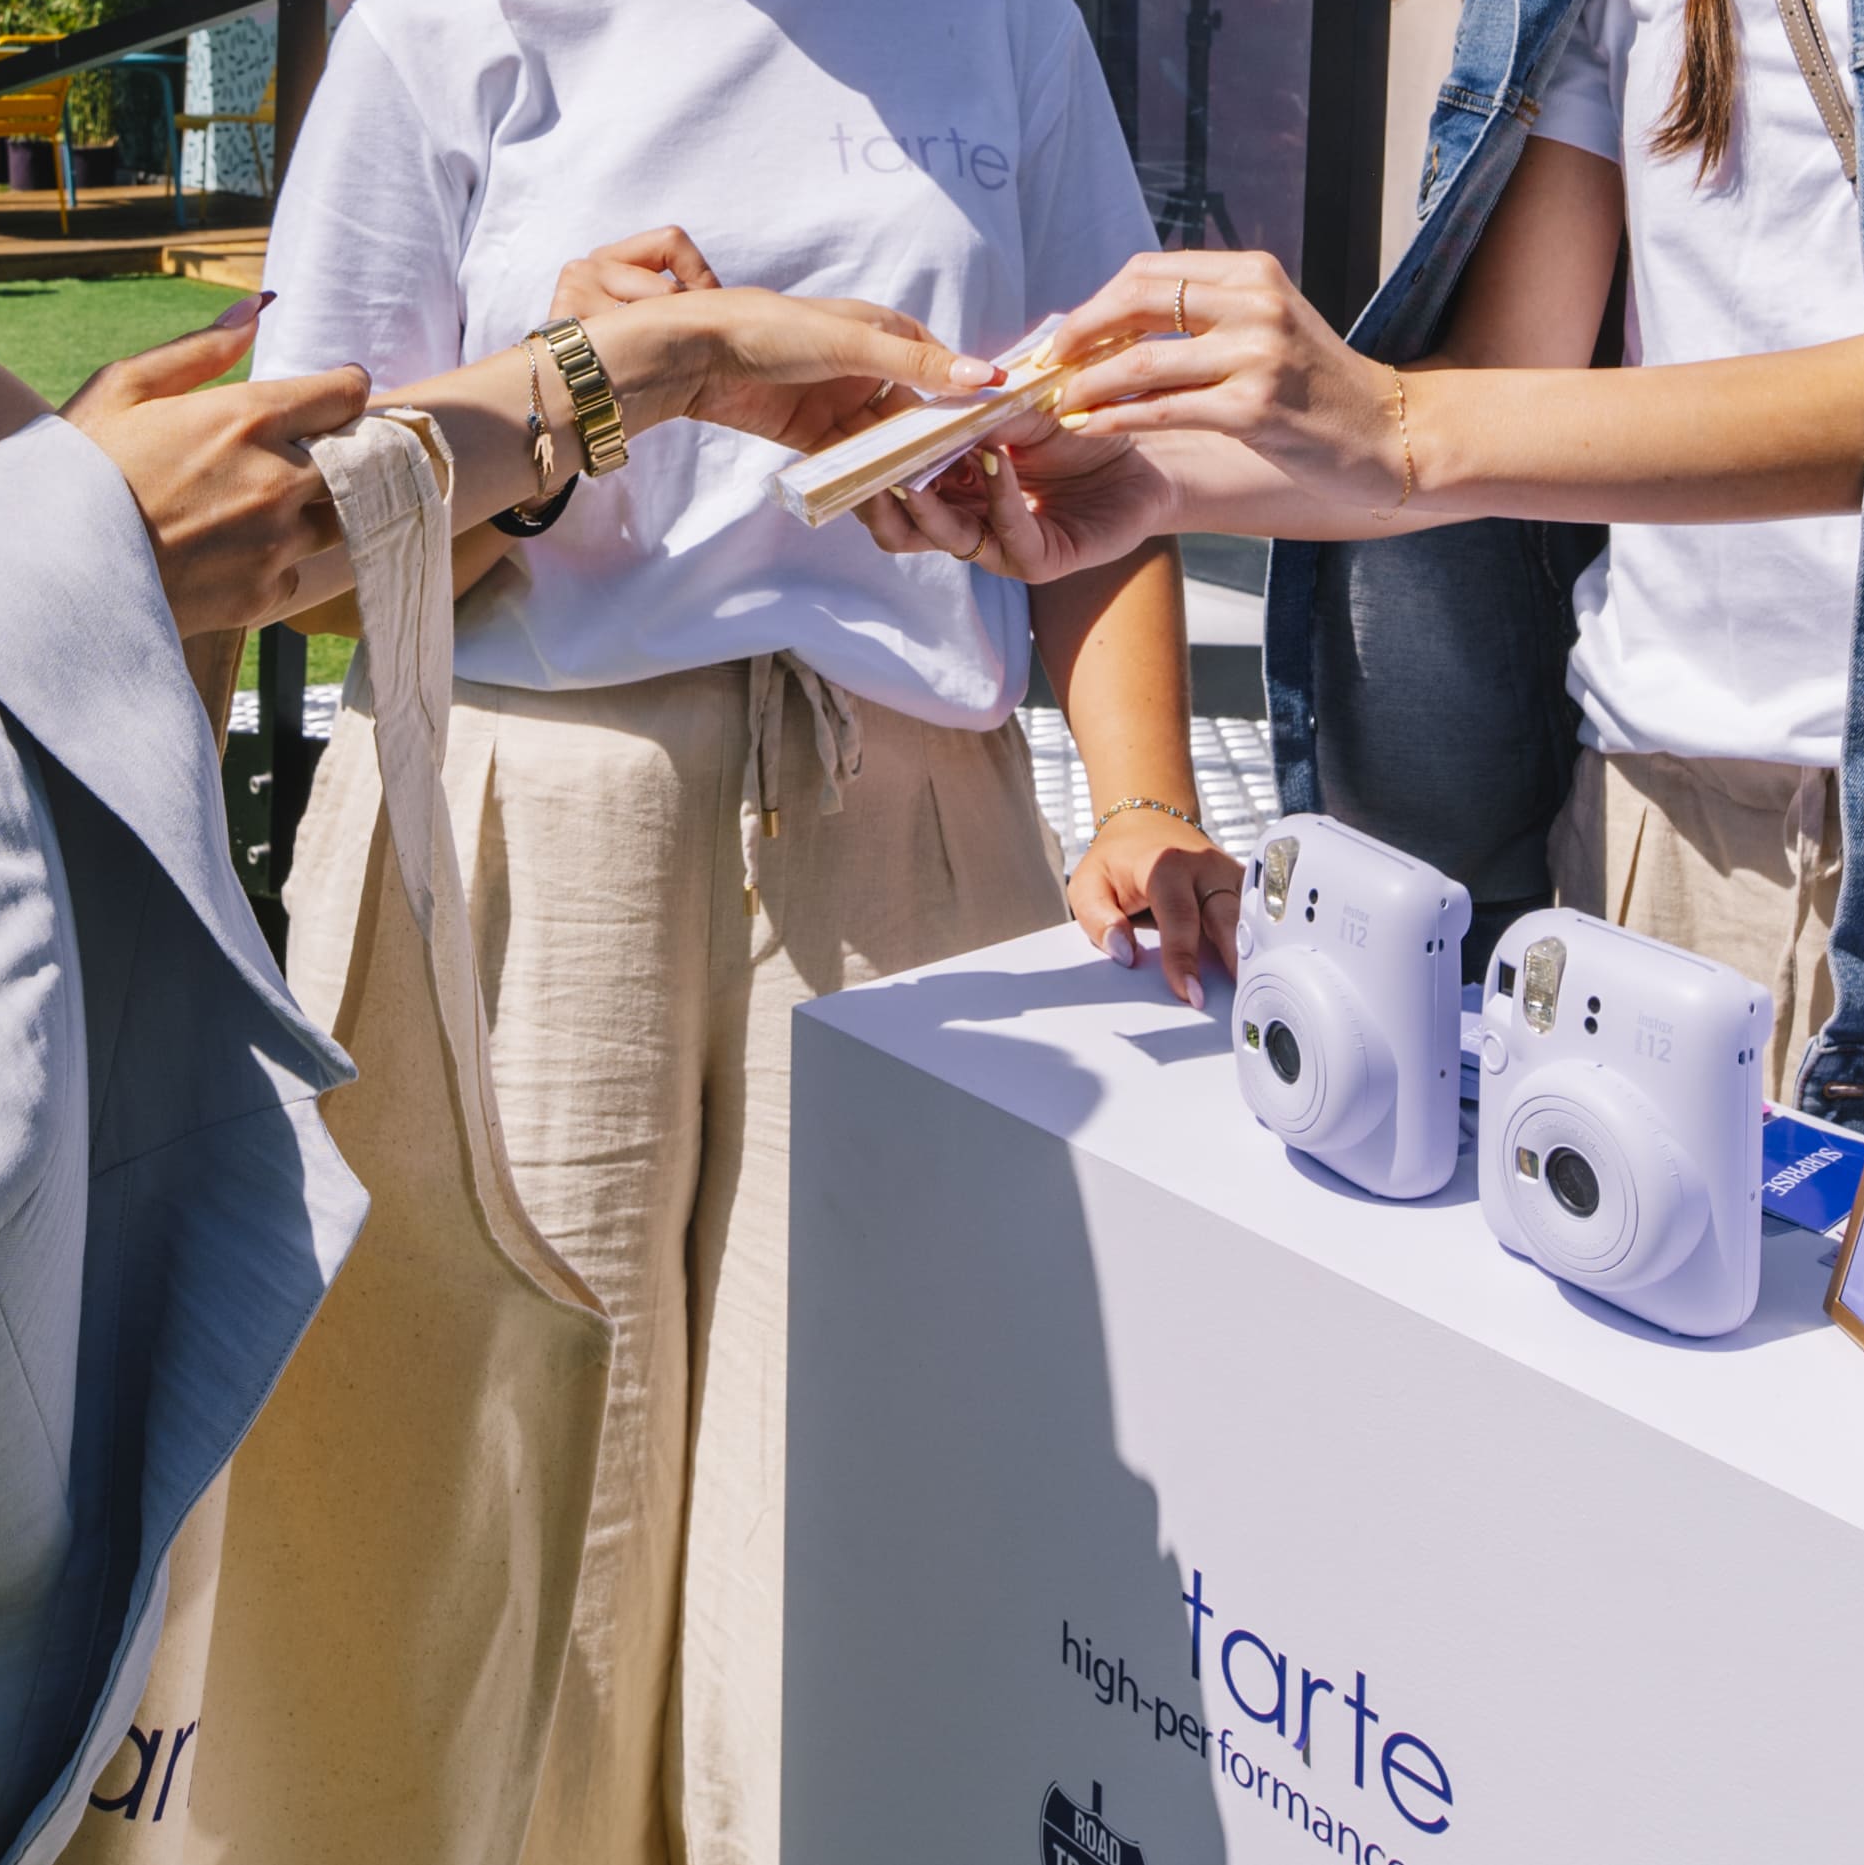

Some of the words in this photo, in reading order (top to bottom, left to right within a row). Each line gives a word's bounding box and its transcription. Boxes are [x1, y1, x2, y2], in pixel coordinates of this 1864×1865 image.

[830, 122, 1011, 191] tarte
[1761, 1147, 1844, 1197] SURPRISE
[1182, 1568, 1453, 1835] tarte
[1062, 1620, 1403, 1865] high-performanc
[1074, 1809, 1121, 1865] ROAD
